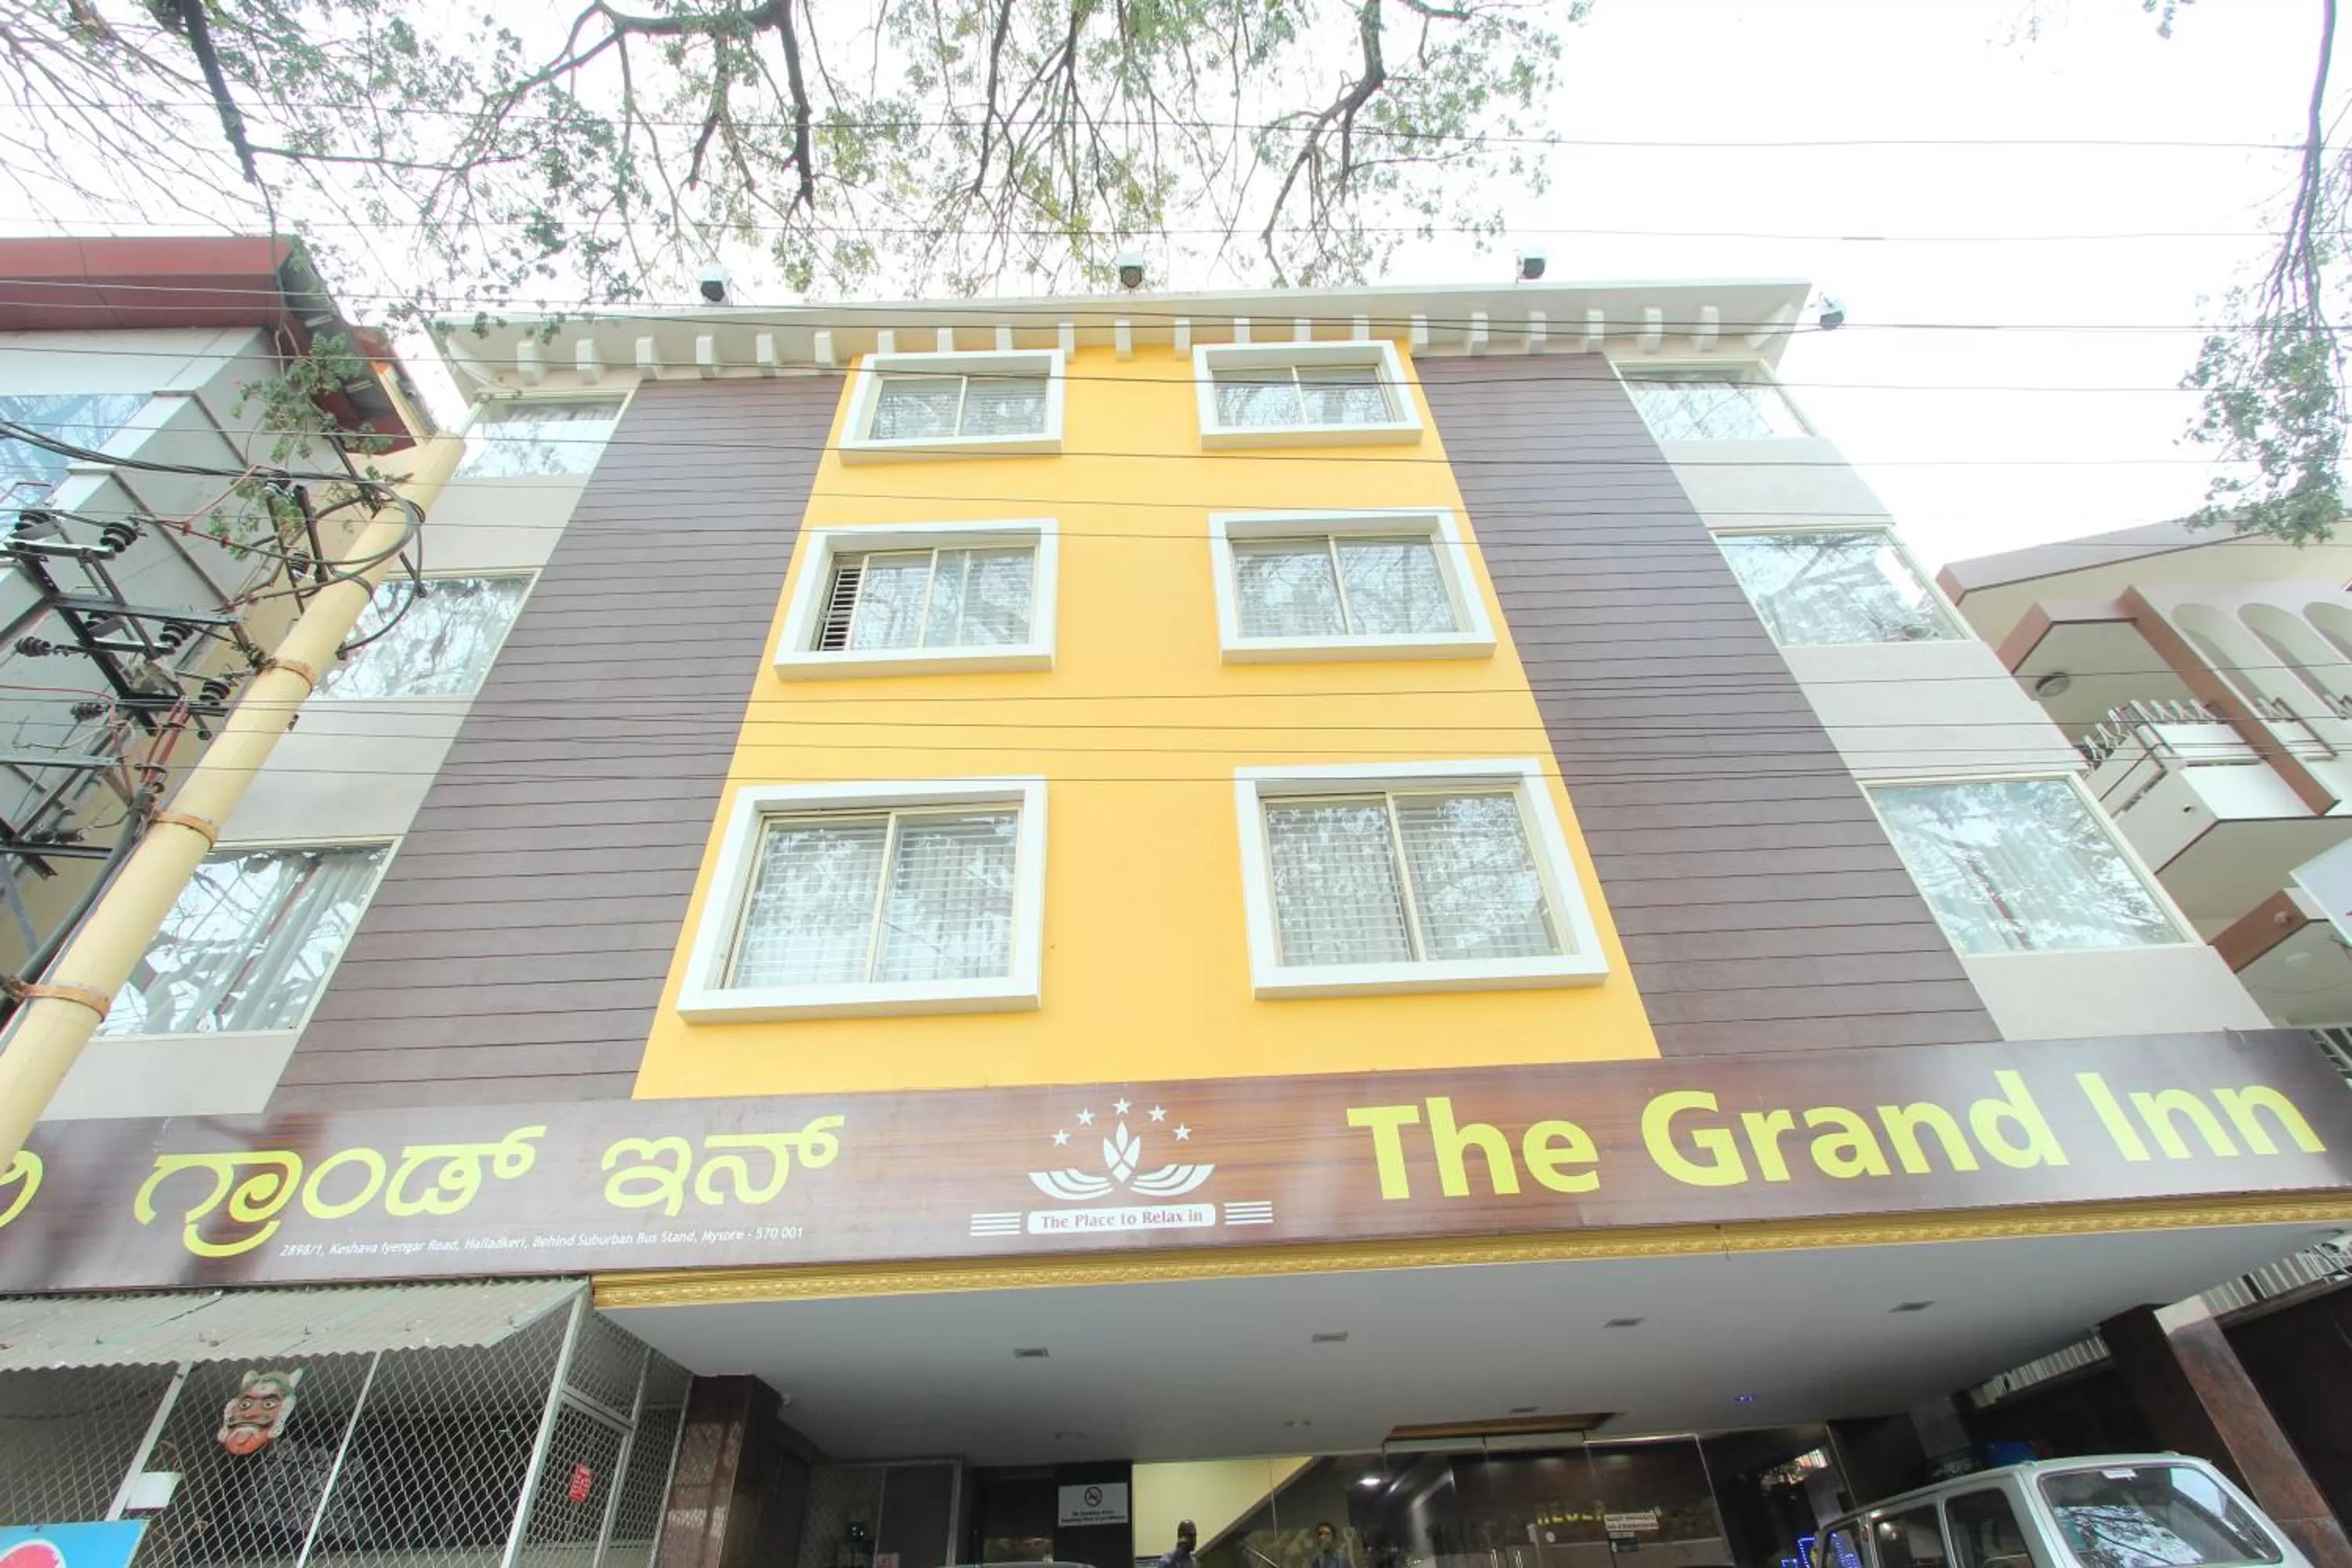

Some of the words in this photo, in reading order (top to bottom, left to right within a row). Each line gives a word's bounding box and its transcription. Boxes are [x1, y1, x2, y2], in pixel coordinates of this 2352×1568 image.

[1347, 1096, 1599, 1202] The
[1640, 1069, 2070, 1187] Grand
[2075, 1073, 2327, 1163] Inn
[1041, 1216, 1069, 1229] The
[1075, 1214, 1116, 1229] Place
[1120, 1214, 1137, 1225] to
[1142, 1210, 1182, 1224] Relax
[1189, 1209, 1203, 1222] in
[329, 1242, 378, 1255] Keshava
[381, 1241, 426, 1255] Iyengar
[532, 1233, 575, 1248] Behind
[577, 1231, 633, 1247] Suburban
[636, 1231, 658, 1245] Bus
[702, 1229, 745, 1245] Mysore
[755, 1226, 779, 1241] 570
[781, 1225, 804, 1240] 001
